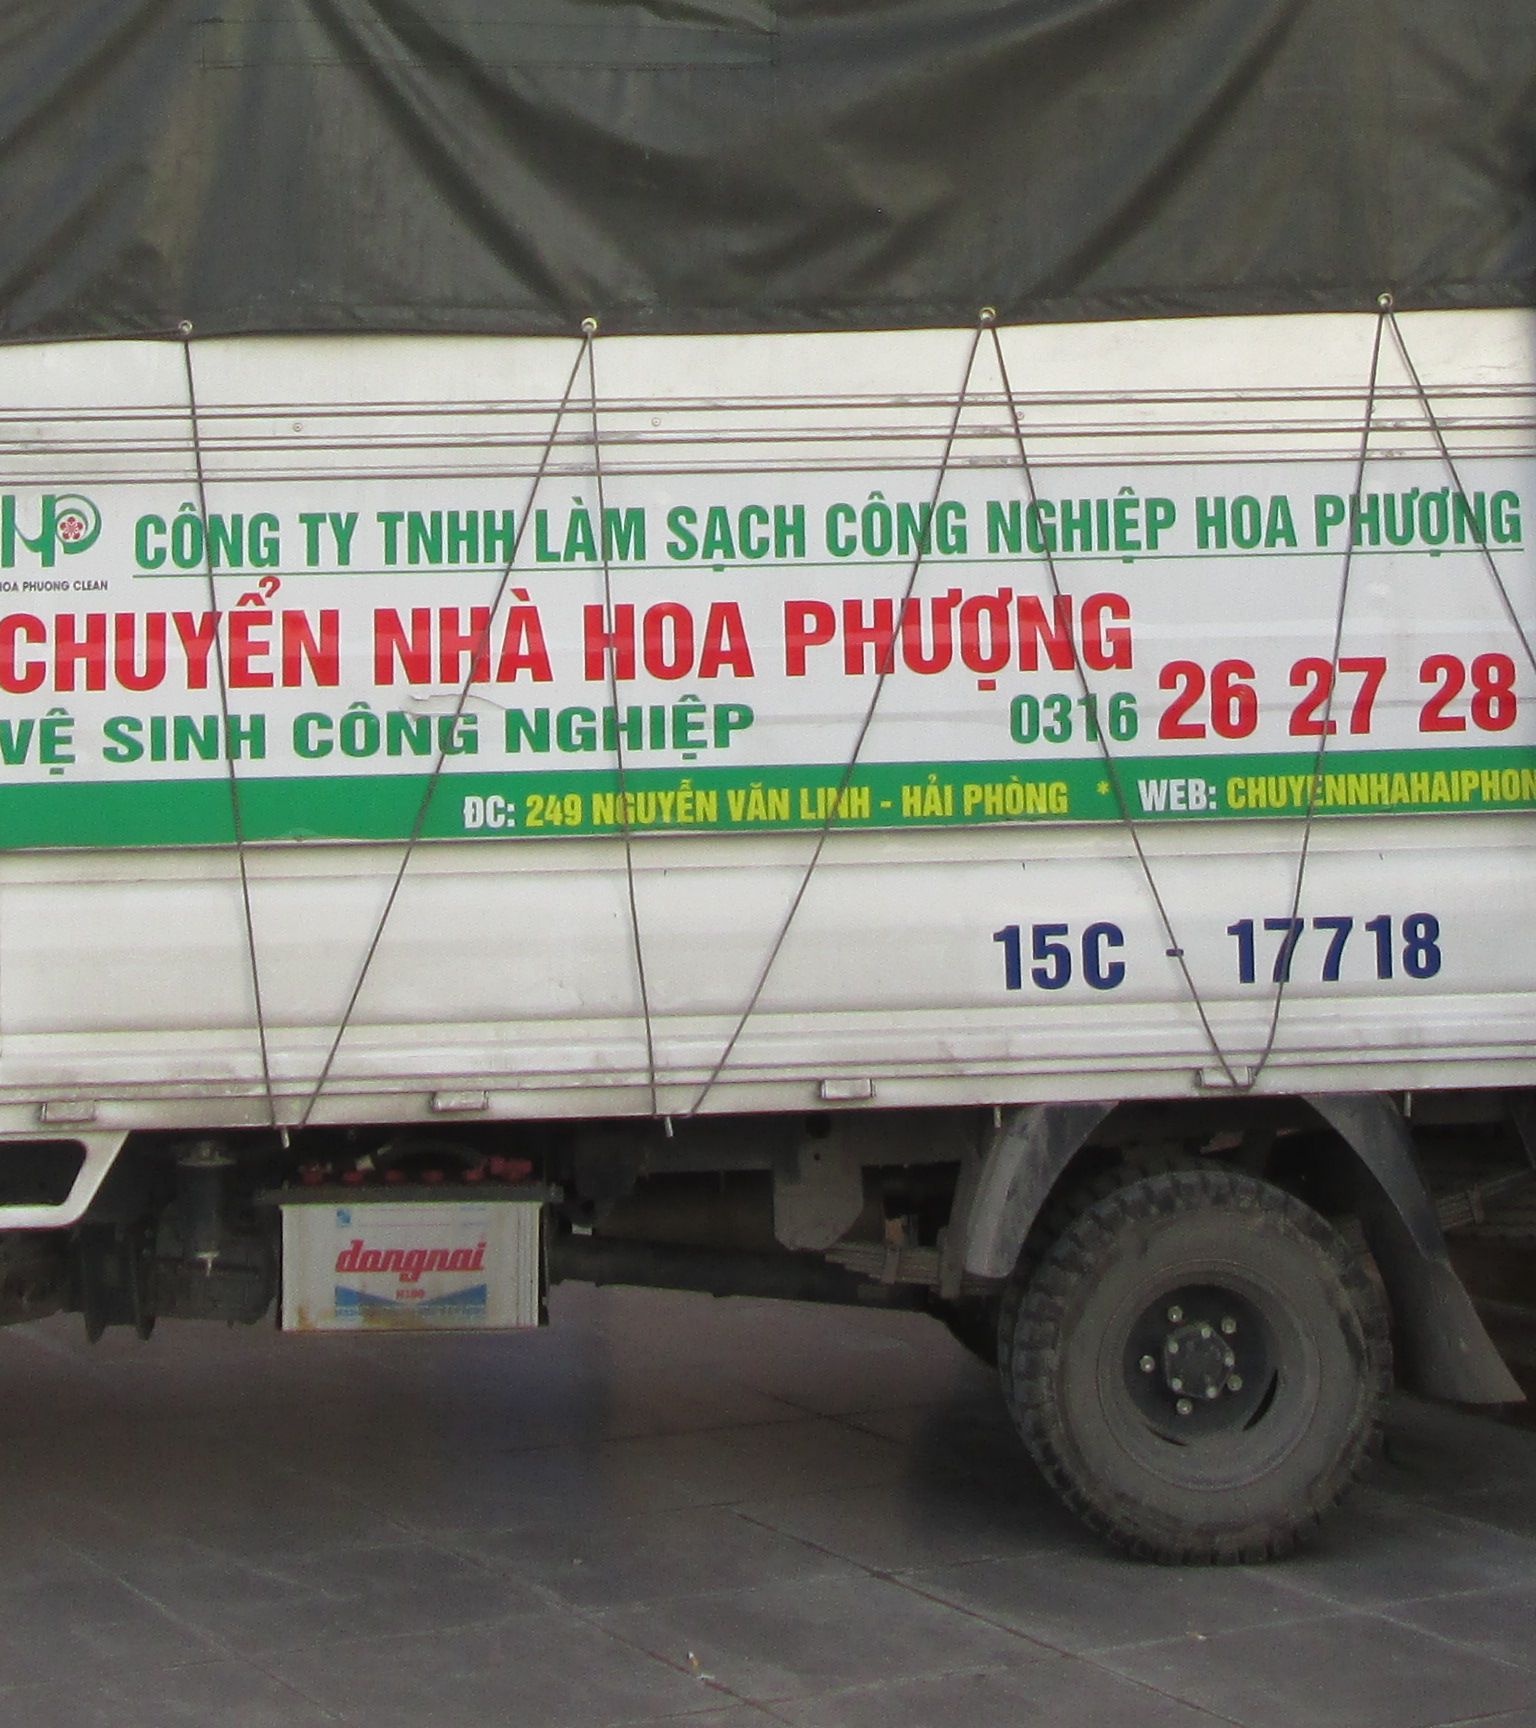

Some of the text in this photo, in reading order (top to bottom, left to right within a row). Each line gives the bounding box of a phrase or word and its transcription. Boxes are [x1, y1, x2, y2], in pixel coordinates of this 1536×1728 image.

[133, 485, 1524, 573] CÔNG TY TNHH LÀM SẠCH CÔNG NGHIỆP HOA PHƯỢNG
[22, 580, 70, 592] PHUONG
[73, 579, 109, 592] CLEAN
[374, 587, 553, 688] NHÀ
[583, 598, 758, 681] HOA
[783, 586, 1134, 692] PHƯỢNG
[101, 712, 264, 765] SINH
[293, 702, 478, 759] CÔNG
[505, 693, 755, 761] NGHIỆP
[1009, 652, 1518, 746] 0316 26 27 28
[462, 793, 517, 830] ĐC:
[525, 791, 583, 829] 249
[592, 777, 718, 828] NGUYỄN
[727, 782, 790, 824] VĂN
[799, 784, 871, 821] LINH
[900, 772, 958, 818] HẢI
[962, 773, 1069, 817] PHÒNG
[1139, 778, 1219, 814] WEB:
[993, 921, 1126, 992] 15C
[1226, 912, 1442, 985] 17718
